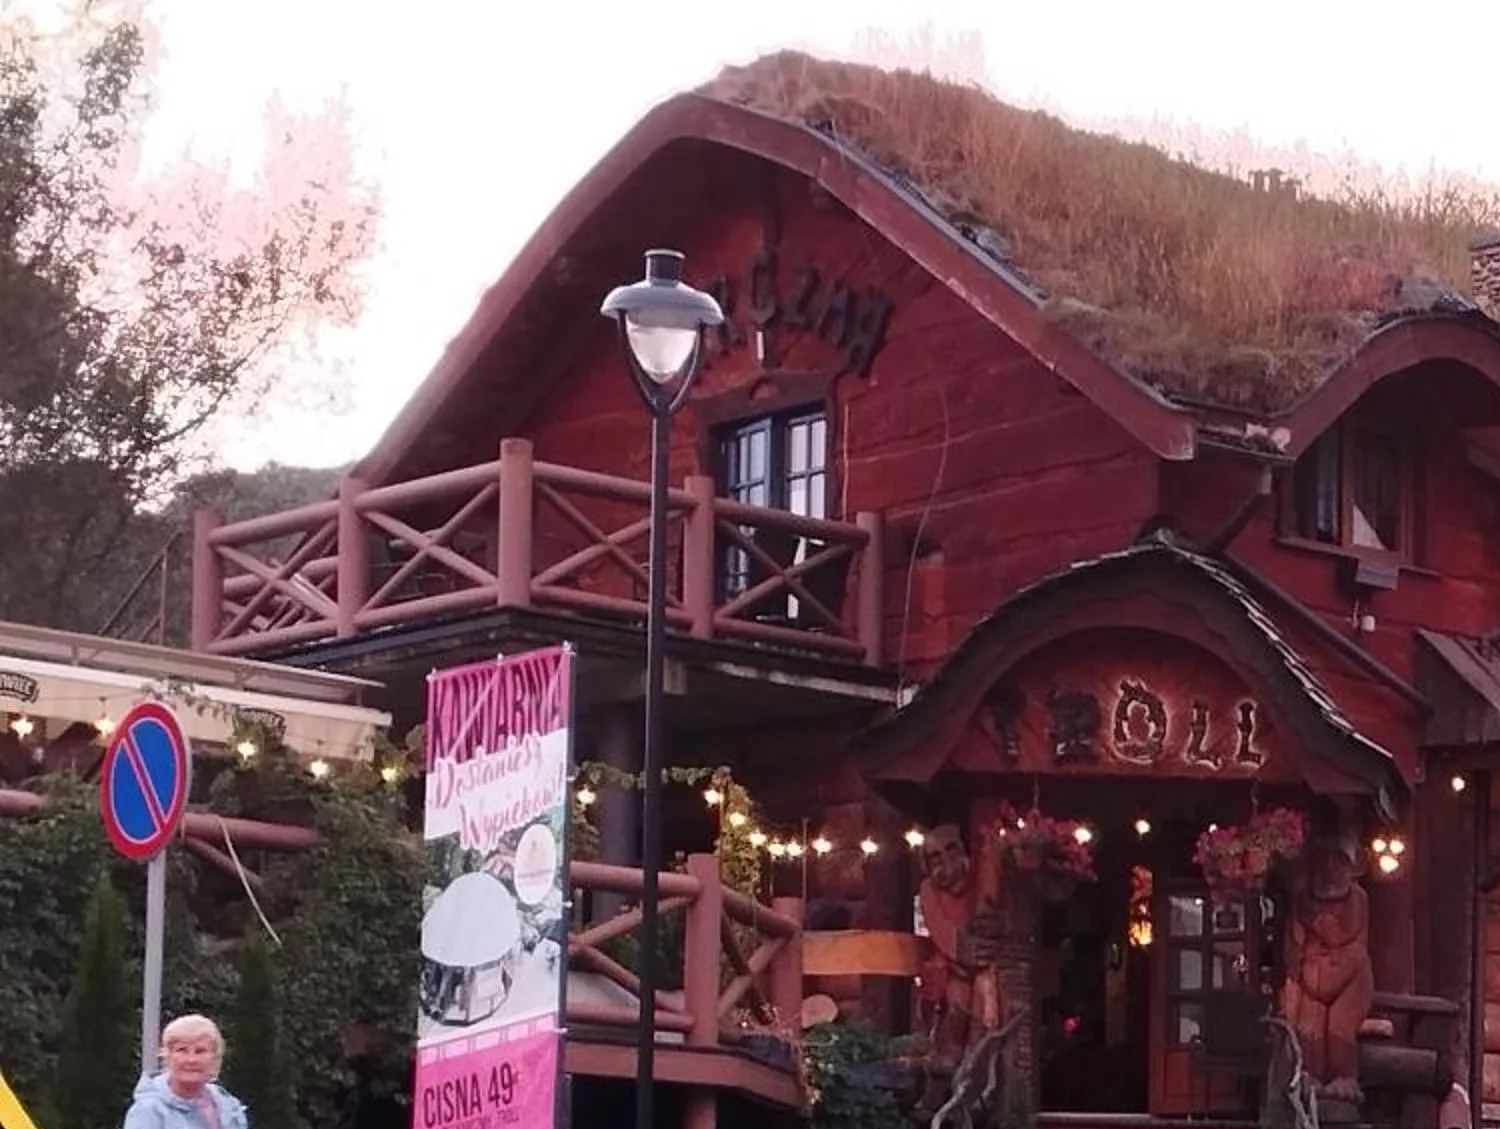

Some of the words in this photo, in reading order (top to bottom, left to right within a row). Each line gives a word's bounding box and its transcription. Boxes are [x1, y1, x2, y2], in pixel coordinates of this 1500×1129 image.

[428, 653, 566, 774] KAWIARNIA
[982, 678, 1267, 770] TROLL
[424, 1072, 482, 1129] CISNA
